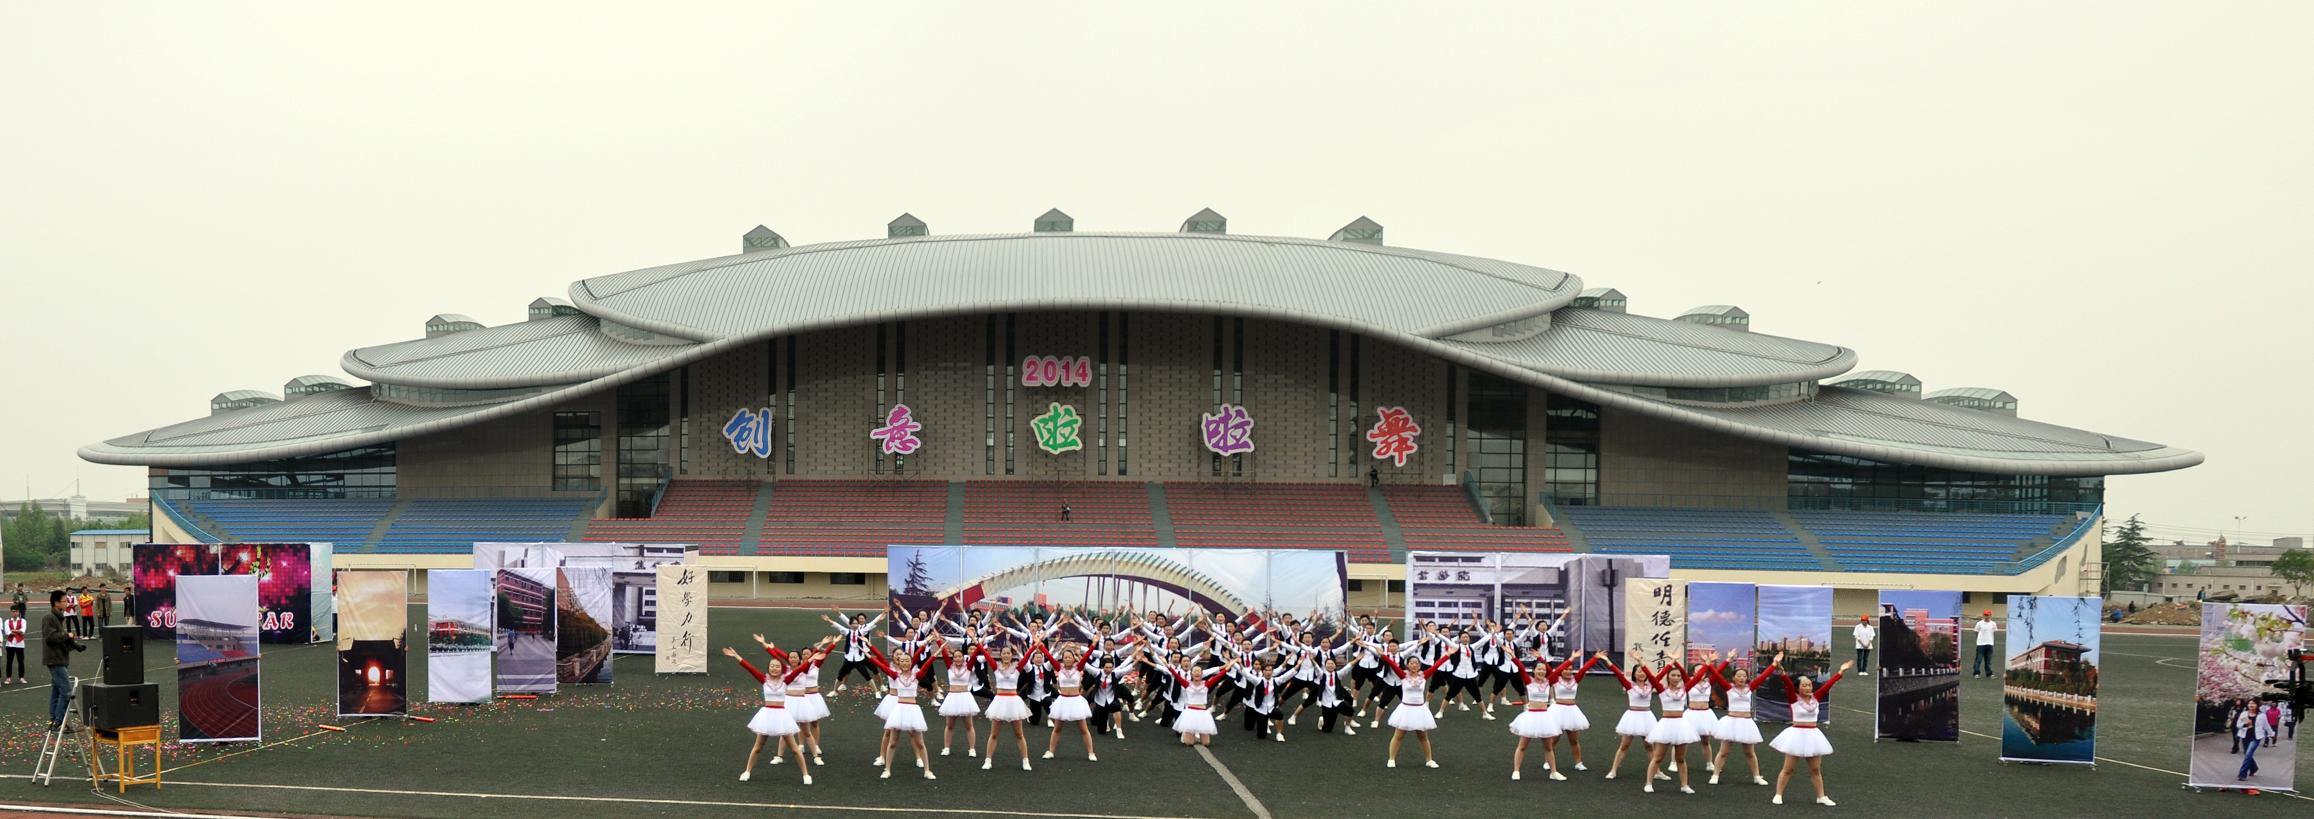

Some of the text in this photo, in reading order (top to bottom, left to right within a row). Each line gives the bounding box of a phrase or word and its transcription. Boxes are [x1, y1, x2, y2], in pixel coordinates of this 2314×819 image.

[1024, 357, 1090, 386] 2014
[724, 404, 1419, 466] 创意啦啦舞
